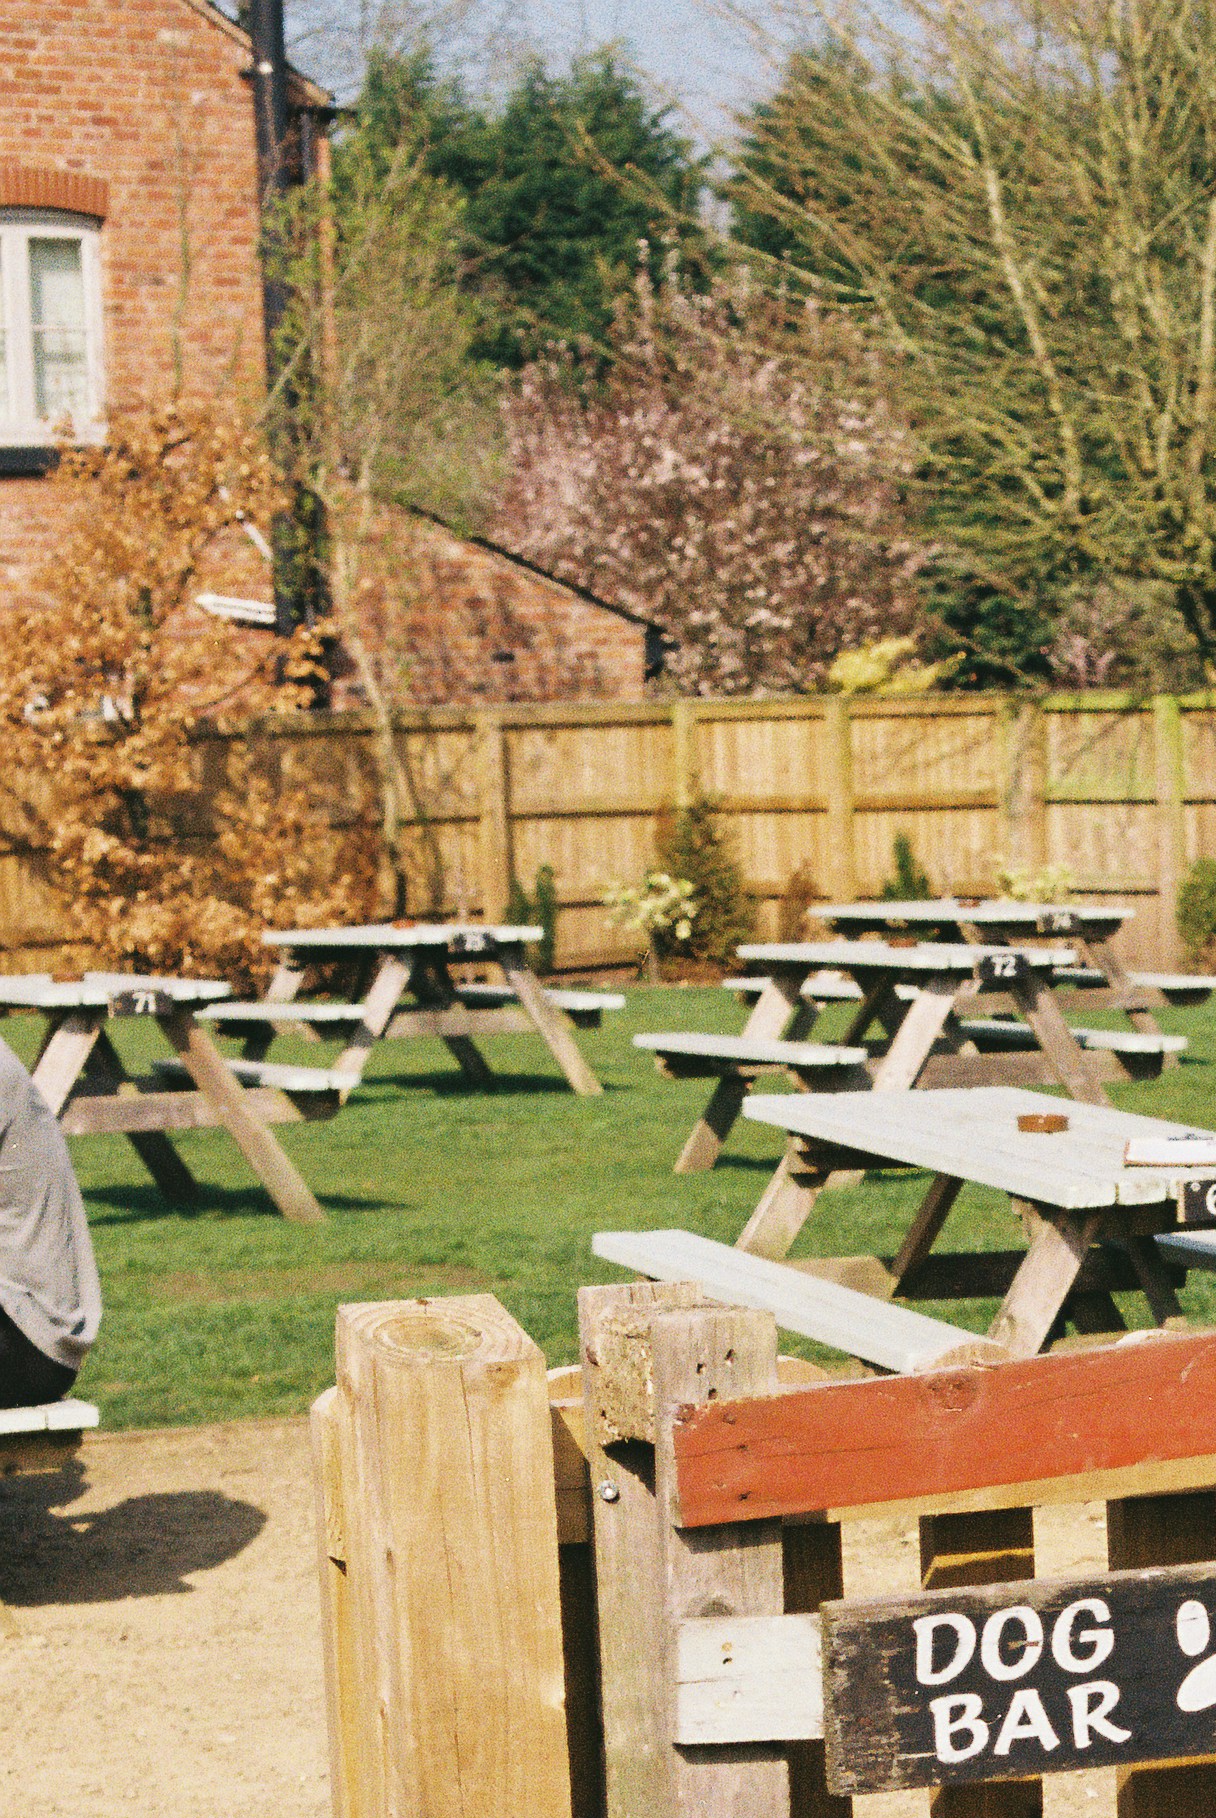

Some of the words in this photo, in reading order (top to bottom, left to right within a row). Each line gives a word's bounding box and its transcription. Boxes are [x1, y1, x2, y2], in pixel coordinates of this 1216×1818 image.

[132, 991, 157, 1014] 71
[912, 1597, 1115, 1687] DOG
[929, 1680, 1133, 1765] BAR
